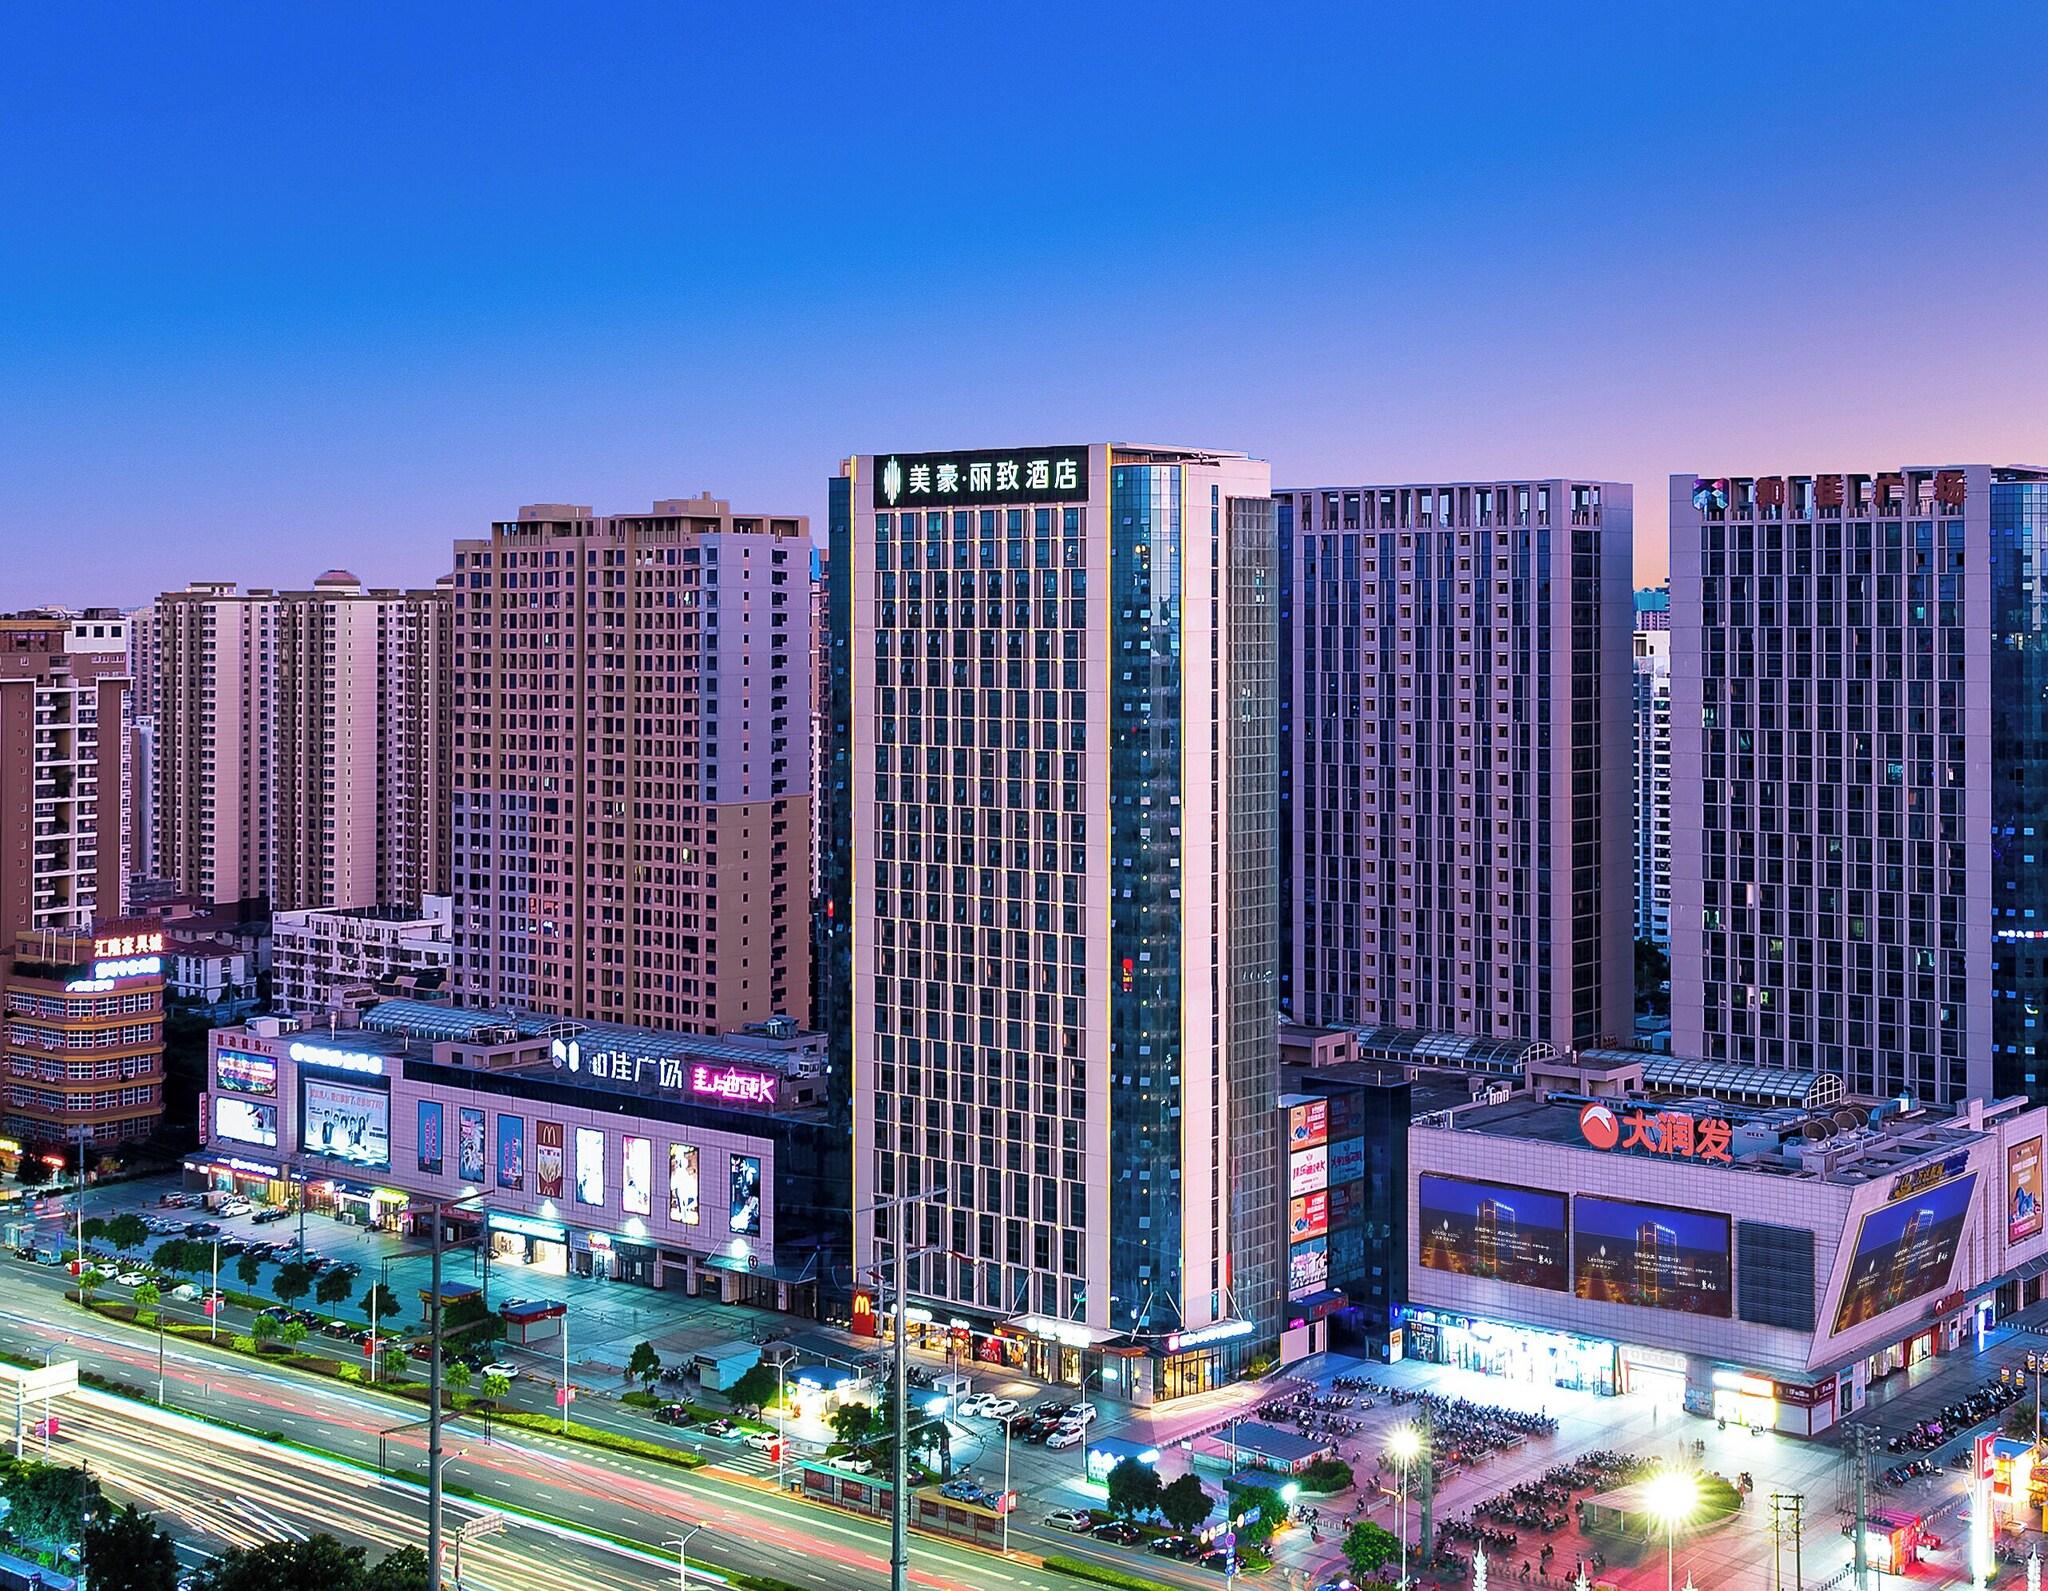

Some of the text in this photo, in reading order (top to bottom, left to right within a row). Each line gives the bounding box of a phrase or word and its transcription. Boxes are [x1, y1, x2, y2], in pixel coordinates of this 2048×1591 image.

[909, 458, 1078, 495] 美豪·丽致酒店
[1621, 1108, 1733, 1163] 大润发
